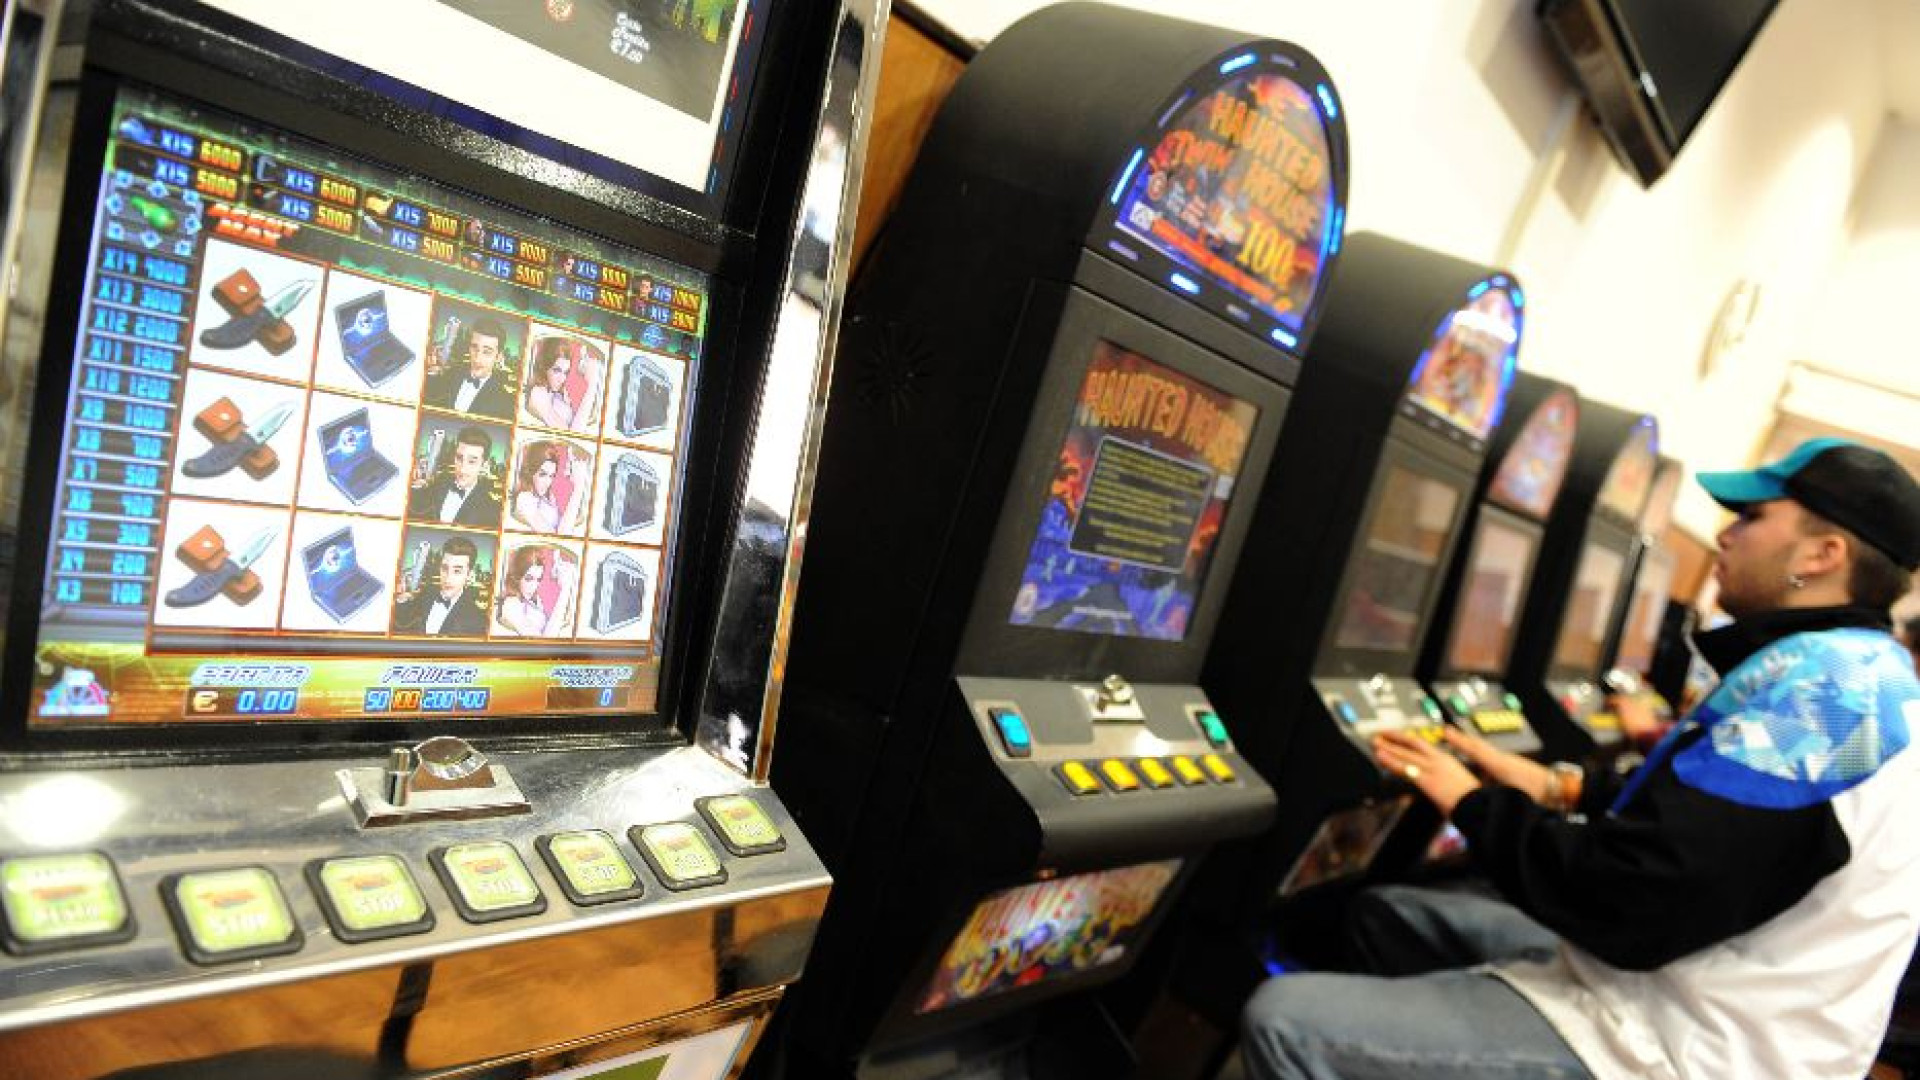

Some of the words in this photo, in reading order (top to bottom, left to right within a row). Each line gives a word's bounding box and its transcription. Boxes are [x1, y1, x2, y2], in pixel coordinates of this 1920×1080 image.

[161, 129, 194, 158] X15
[155, 159, 190, 186] X15
[286, 168, 315, 195] X15
[281, 195, 310, 221] X15
[394, 202, 421, 226] X15
[390, 228, 418, 251] X15
[491, 233, 514, 254] X15
[1238, 217, 1297, 290] 100
[488, 256, 511, 279] X15
[99, 277, 134, 304] X13
[140, 285, 183, 314] 3000
[95, 308, 128, 333] X12
[135, 315, 178, 342] 2000
[91, 337, 122, 362] X11
[133, 344, 174, 371] 1500
[86, 367, 120, 393] X10
[129, 374, 170, 400] 1200
[125, 403, 165, 428] 1000
[73, 457, 98, 481] X7
[124, 464, 158, 487] 500
[117, 523, 150, 546] 300
[112, 552, 146, 575] 200
[111, 581, 143, 605] 100
[380, 664, 480, 685] POWER
[235, 689, 297, 713] 0.00
[364, 689, 391, 712] 50
[393, 689, 422, 711] 100
[422, 689, 455, 711] 200
[456, 689, 487, 711] 400
[600, 688, 613, 707] 0
